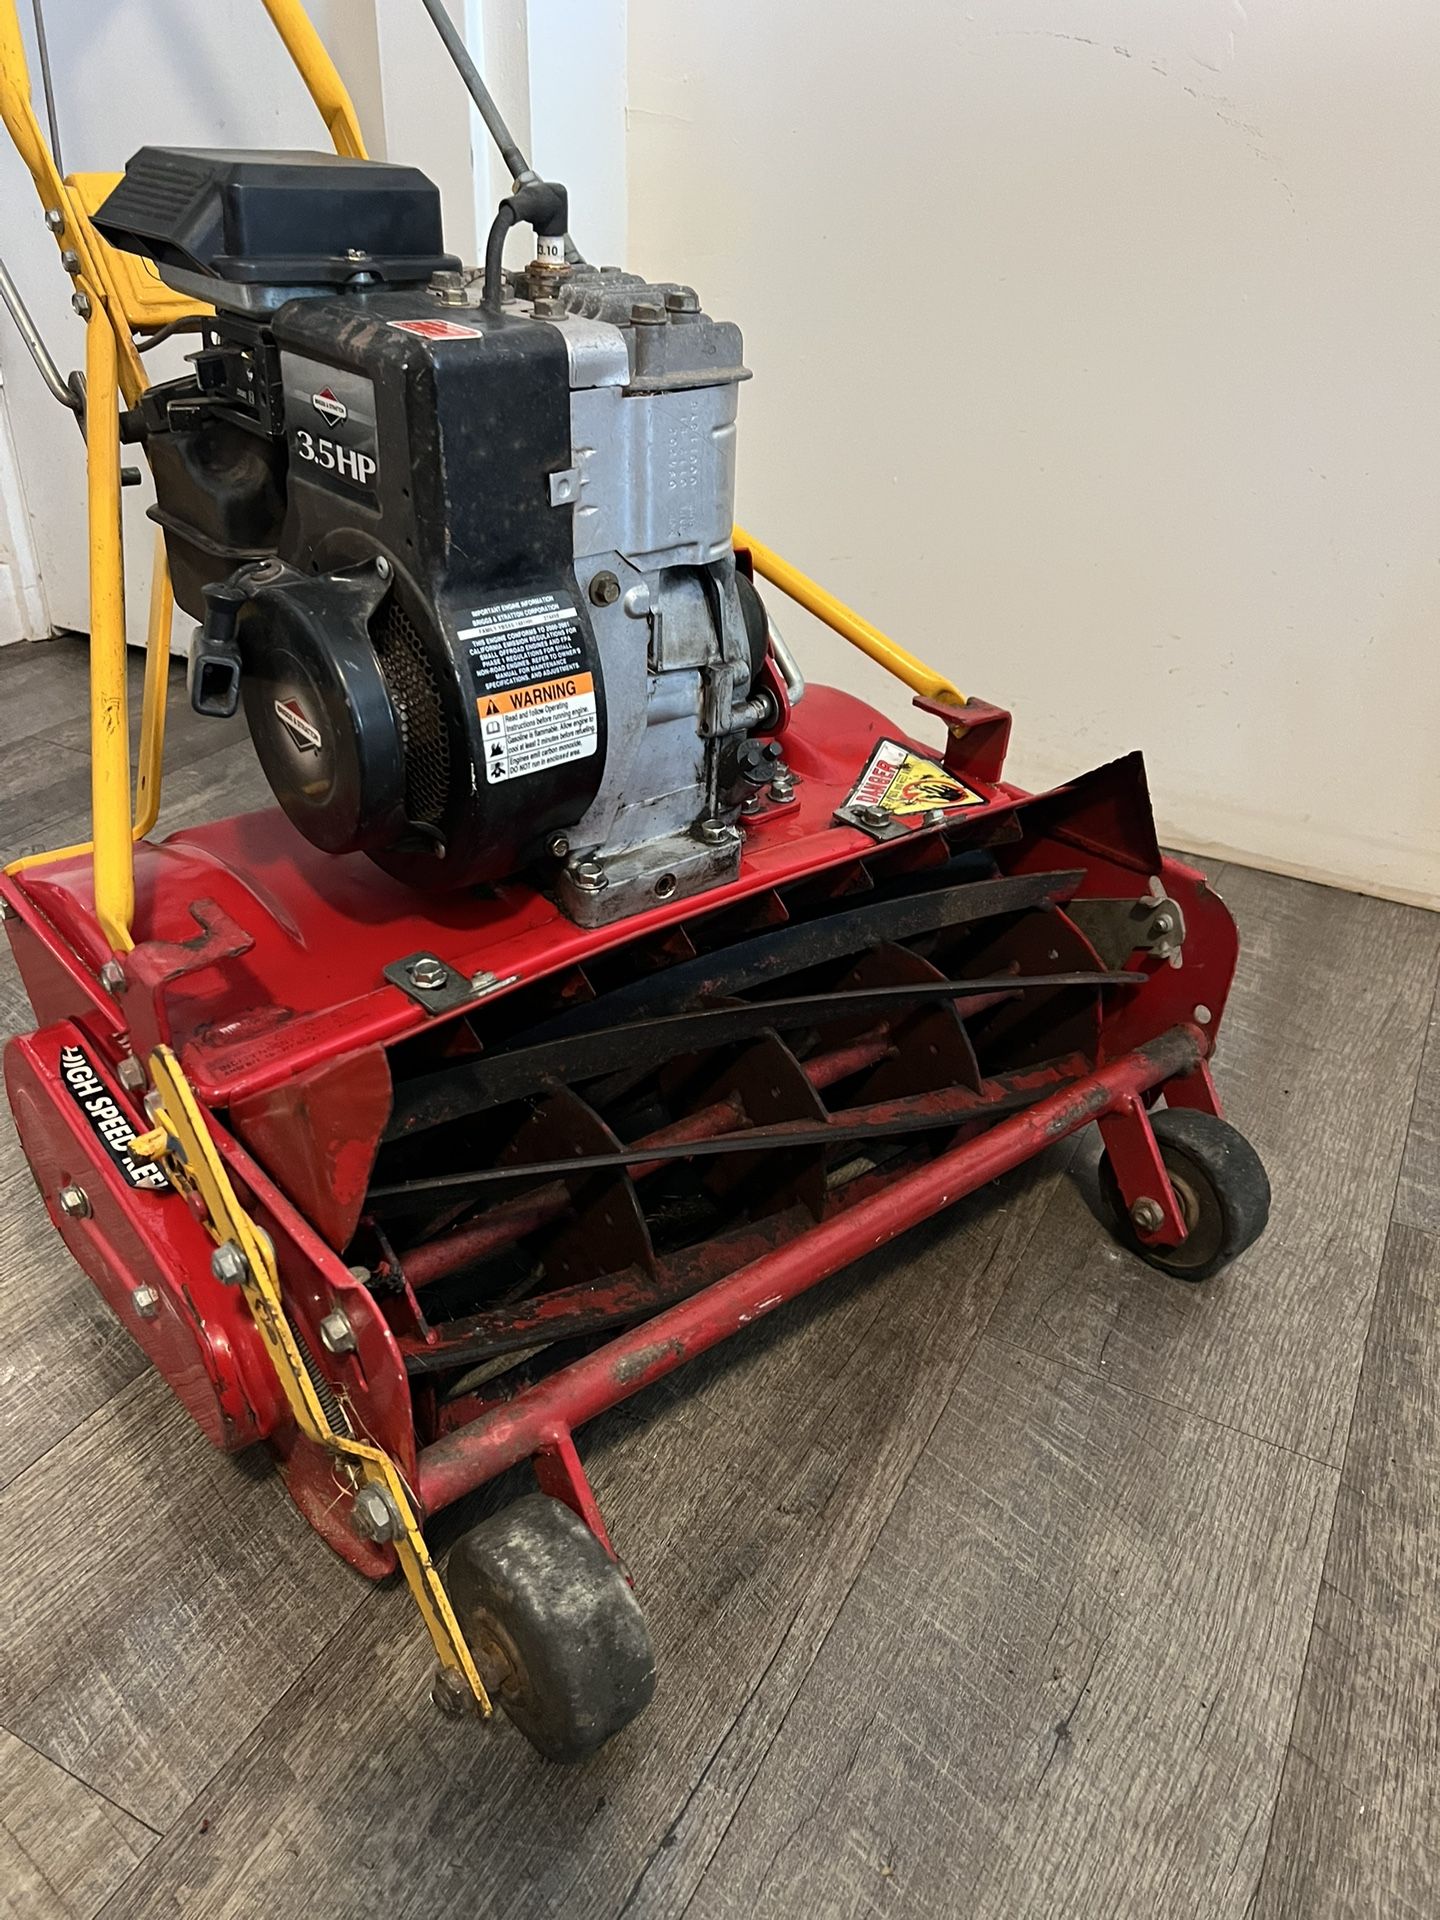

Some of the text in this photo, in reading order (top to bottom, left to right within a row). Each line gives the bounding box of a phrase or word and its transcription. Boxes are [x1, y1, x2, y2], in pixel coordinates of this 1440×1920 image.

[297, 430, 377, 484] 3.5HP
[501, 602, 520, 612] ENGINE
[525, 604, 560, 616] CORPORATION
[469, 626, 577, 656] CALIFORNIA EMISSION REGULATIONS FOR
[472, 638, 486, 648] THIS
[486, 634, 506, 644] ENGINE
[507, 628, 538, 640] CONFORMS
[480, 651, 499, 662] SMALL
[499, 646, 525, 657] OFFROAD
[526, 641, 548, 652] ENGINES
[549, 638, 561, 646] AND
[476, 665, 506, 677] NON-ROAD
[531, 656, 550, 666] REFER
[482, 658, 501, 668] PHASE
[506, 649, 544, 662] REGULATIONS
[543, 646, 554, 655] FOR
[555, 643, 573, 652] SMALL
[495, 658, 567, 680] MANUAL FOR MAINTENANCE
[530, 671, 543, 679] AND
[510, 680, 577, 709] WARNING
[505, 702, 569, 722] Read and follow Operating
[506, 706, 589, 732] Instructions before running engine.
[508, 732, 528, 744] Gasoline
[560, 722, 572, 730] Allow
[572, 718, 588, 729] engine
[508, 746, 519, 754] cool
[524, 740, 537, 750] least
[540, 735, 559, 746] minutes
[559, 730, 574, 740] before
[574, 725, 596, 737] refueling.
[510, 754, 530, 766] Engines
[530, 751, 540, 760] emit
[541, 746, 558, 756] carbon
[510, 766, 519, 774] DO
[520, 763, 531, 772] NOT
[531, 760, 540, 768] run
[546, 751, 570, 764] enclosed
[569, 748, 581, 758] area.
[855, 759, 898, 804] DANGER
[85, 1096, 137, 1151] SPEED
